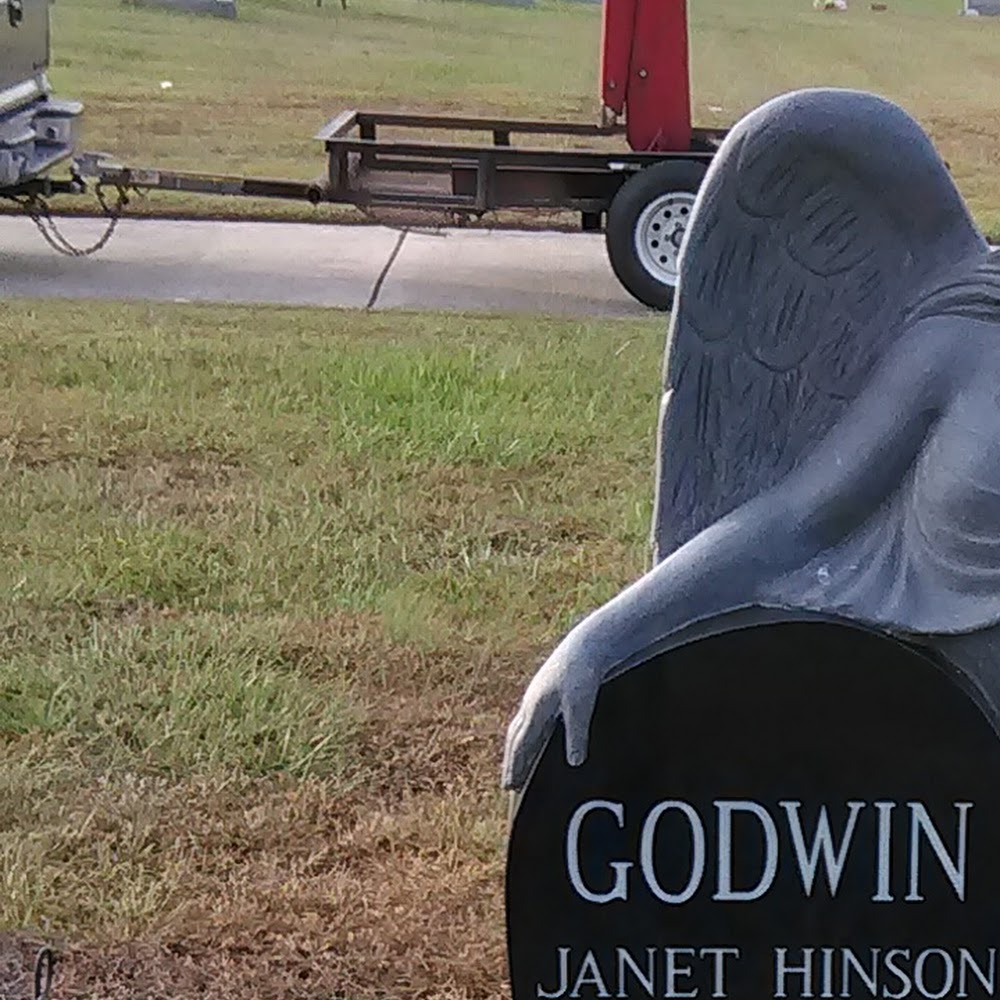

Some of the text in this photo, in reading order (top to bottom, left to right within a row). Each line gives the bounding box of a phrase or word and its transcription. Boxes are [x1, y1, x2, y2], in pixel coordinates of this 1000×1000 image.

[566, 800, 973, 904] GODWIN
[537, 947, 996, 999] JANET HINSON
